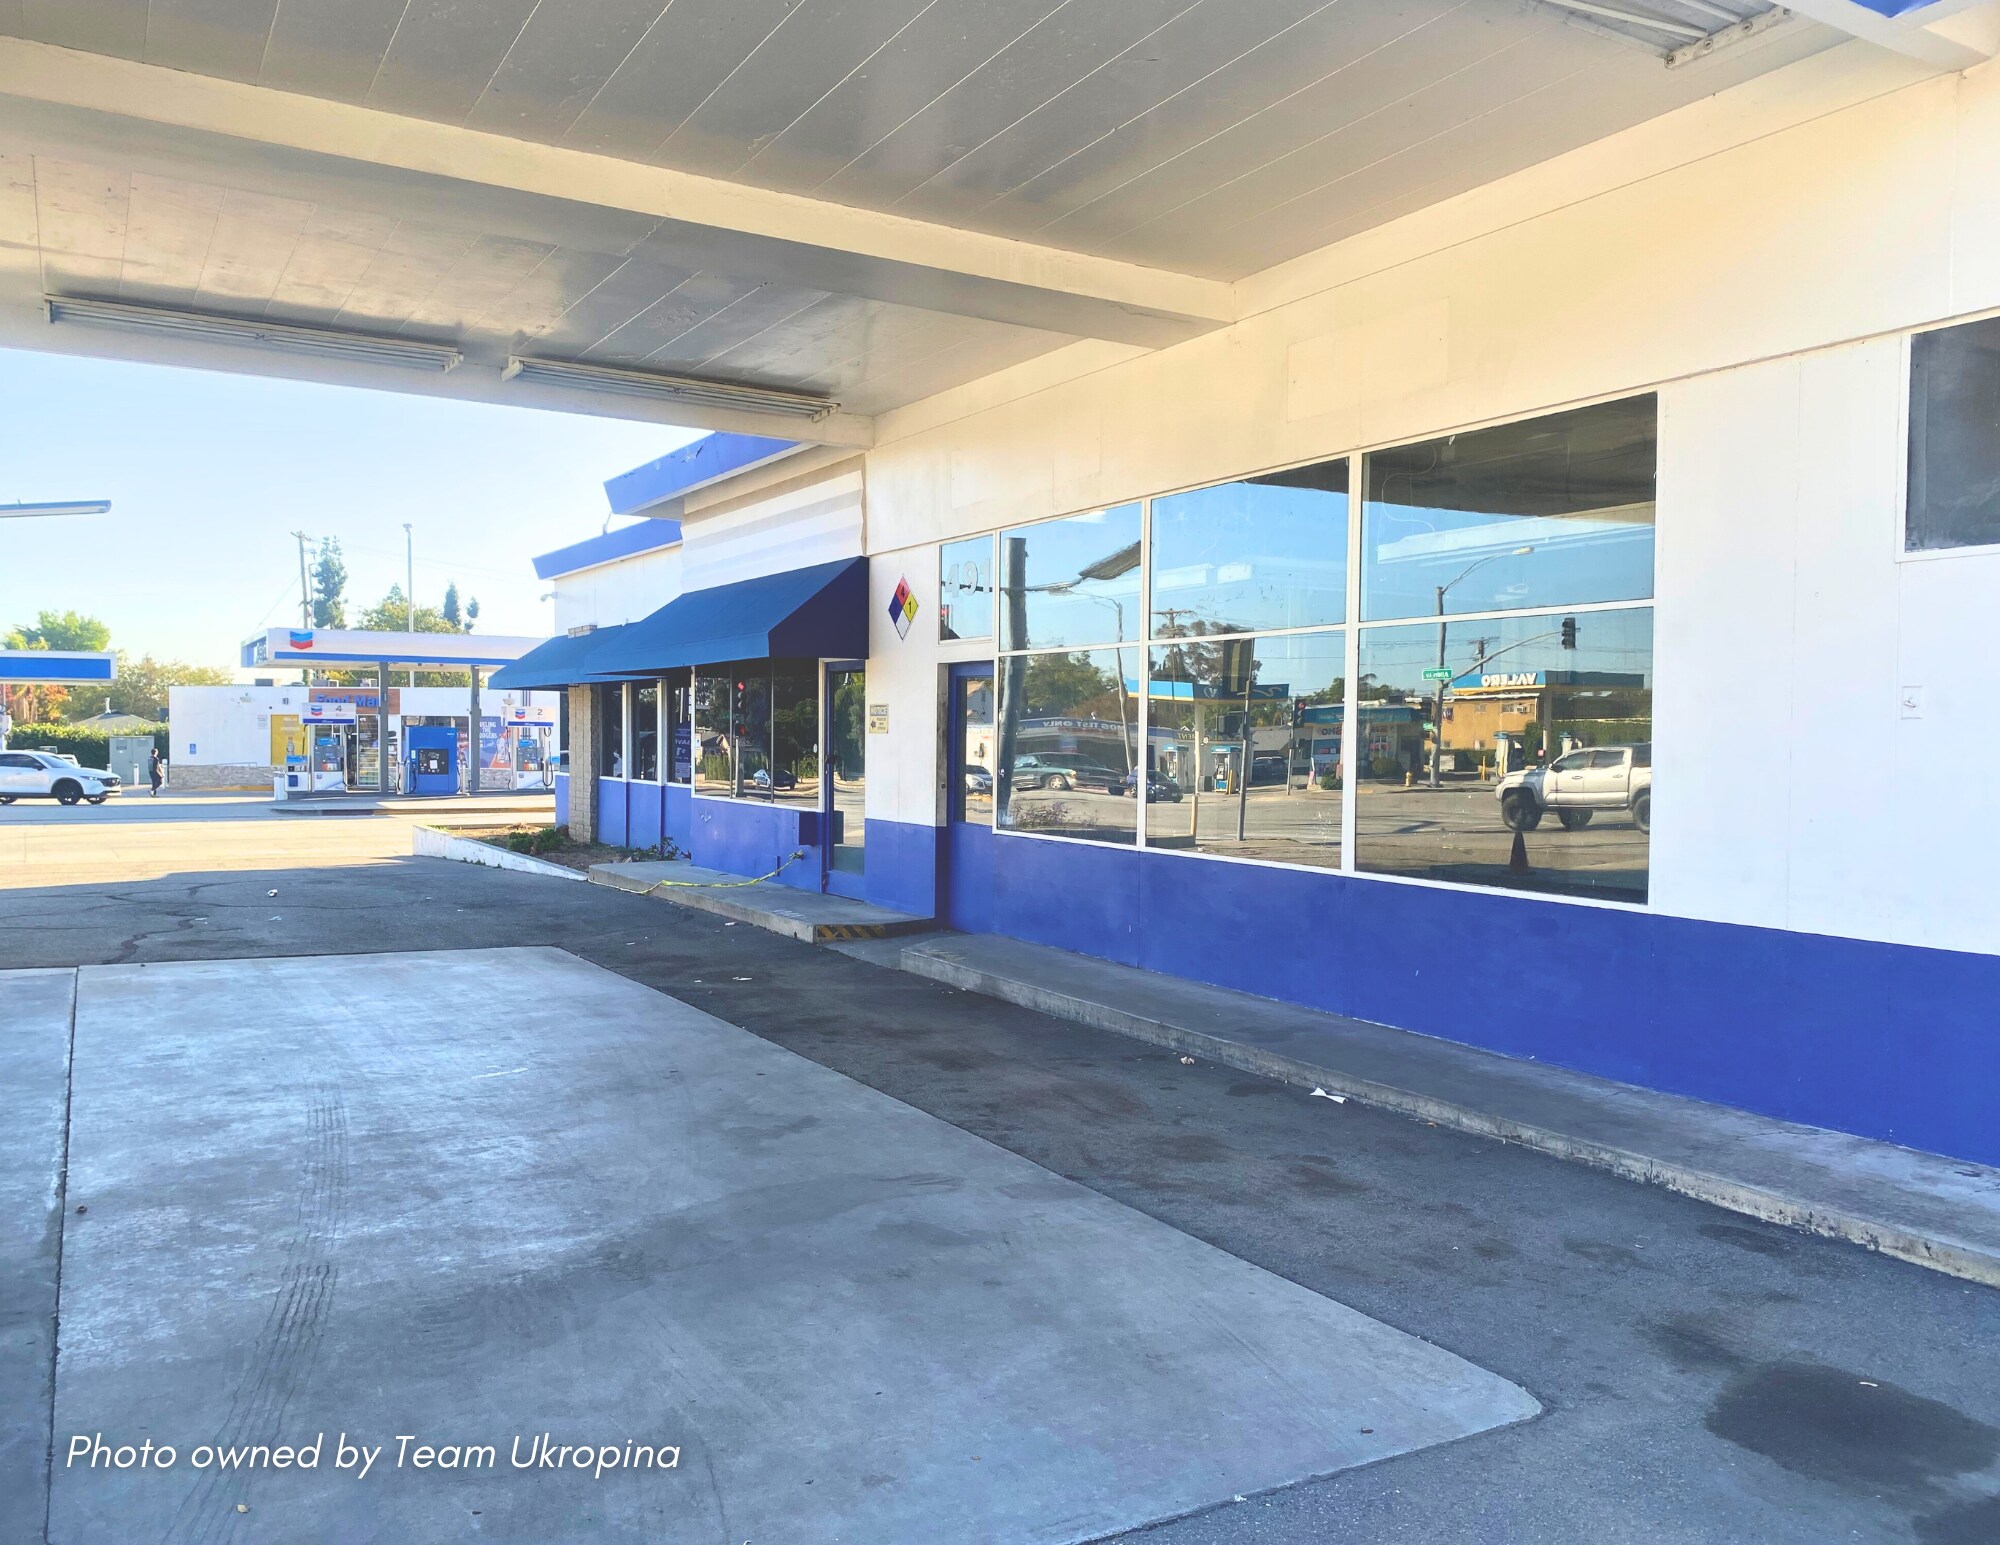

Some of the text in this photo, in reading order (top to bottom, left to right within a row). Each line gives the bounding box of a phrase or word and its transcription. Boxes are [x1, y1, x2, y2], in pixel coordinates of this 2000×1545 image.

[945, 557, 991, 598] 491
[900, 585, 906, 598] 4
[908, 601, 912, 613] 1
